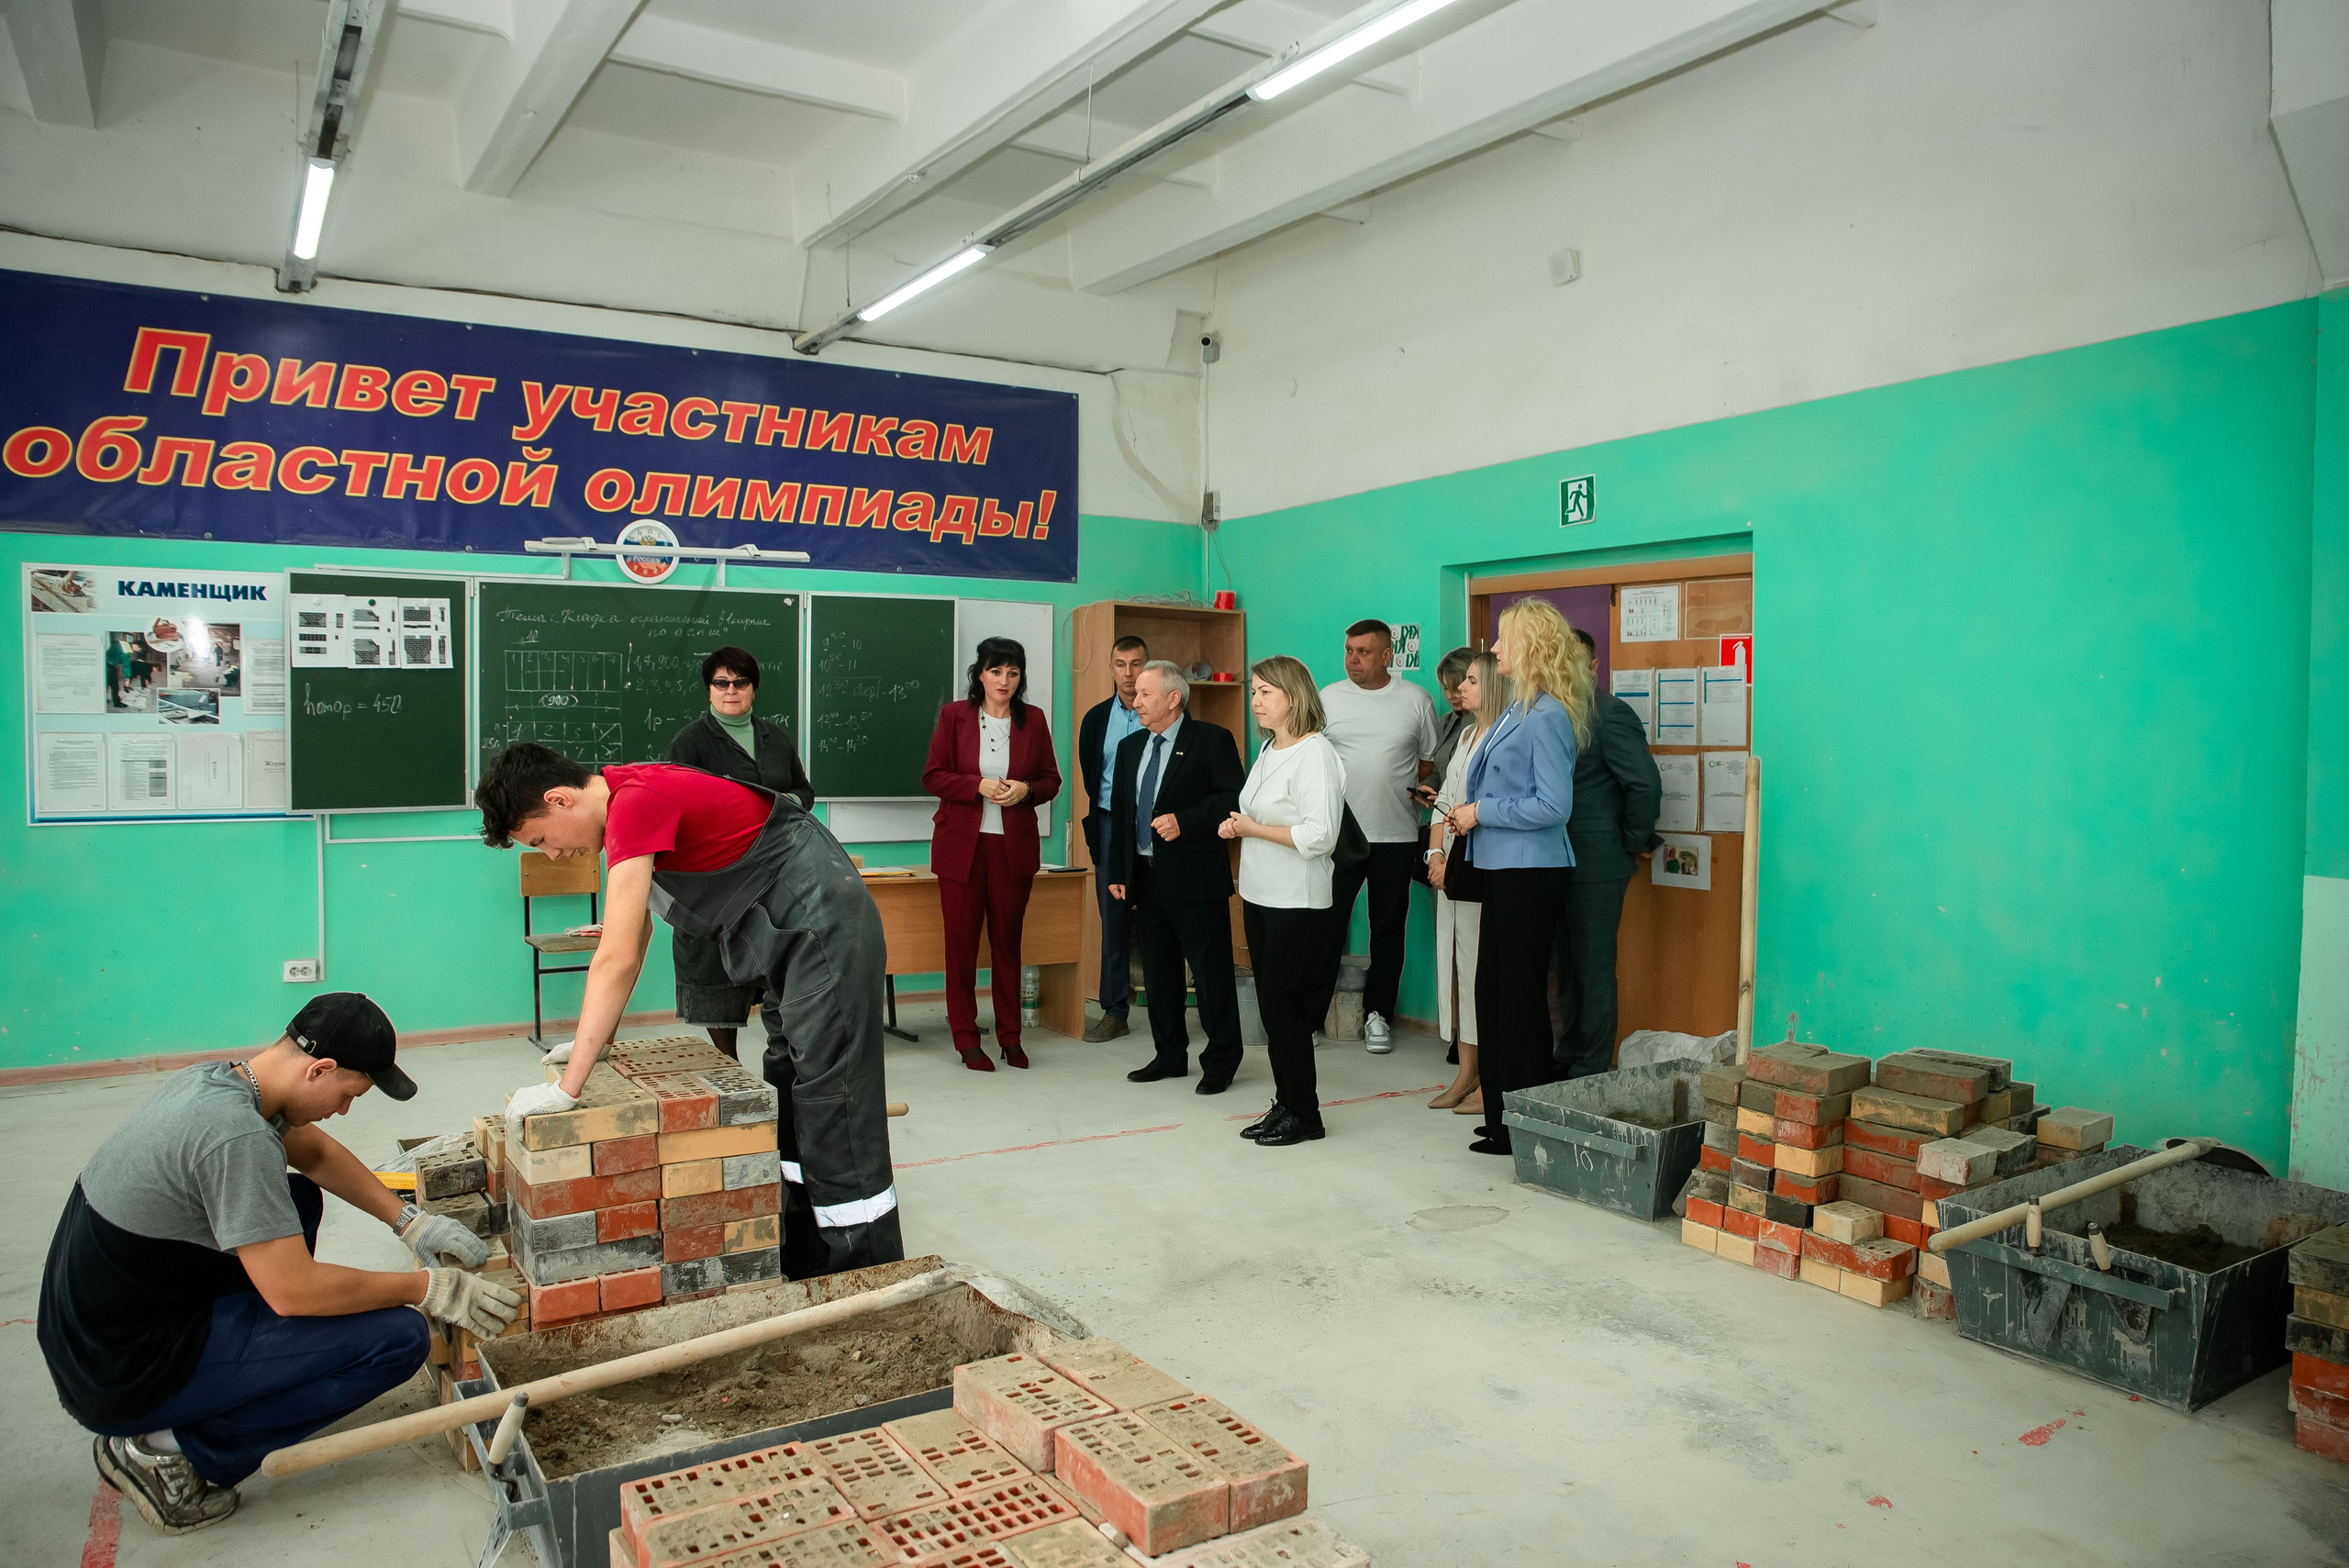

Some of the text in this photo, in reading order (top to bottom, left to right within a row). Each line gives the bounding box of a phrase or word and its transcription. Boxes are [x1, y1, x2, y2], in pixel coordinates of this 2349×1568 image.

[123, 326, 994, 465] Привет участникам
[3, 415, 1057, 546] областной олимпиады!
[117, 580, 268, 603] КАМЕНЩИК
